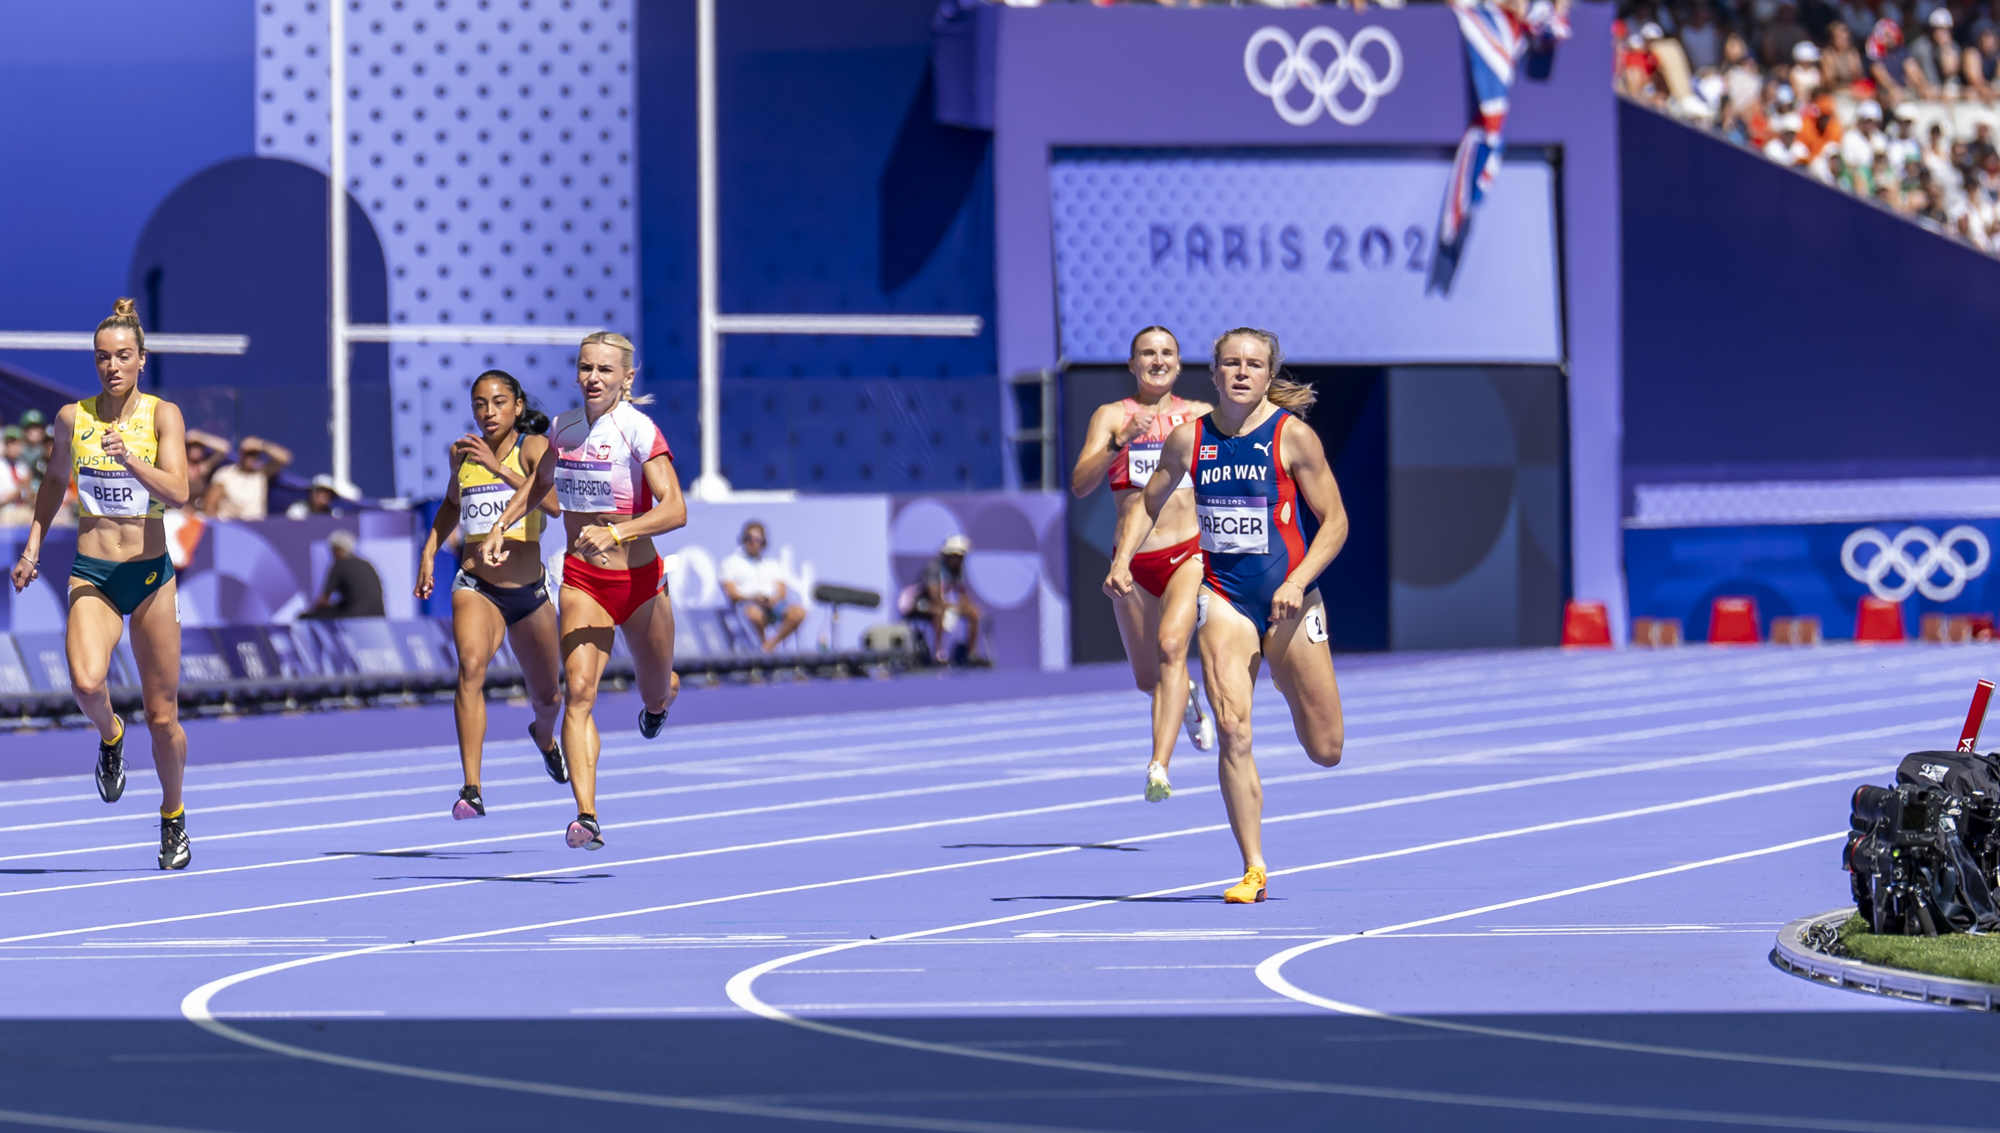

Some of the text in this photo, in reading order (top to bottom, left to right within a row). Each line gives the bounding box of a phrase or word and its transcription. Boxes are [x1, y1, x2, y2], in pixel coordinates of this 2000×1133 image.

[1149, 222, 1432, 274] PARIS 202
[75, 455, 152, 466] AUSTA
[1200, 464, 1267, 486] NORWAY
[93, 485, 133, 502] BEER
[1198, 514, 1263, 535] JAEGER
